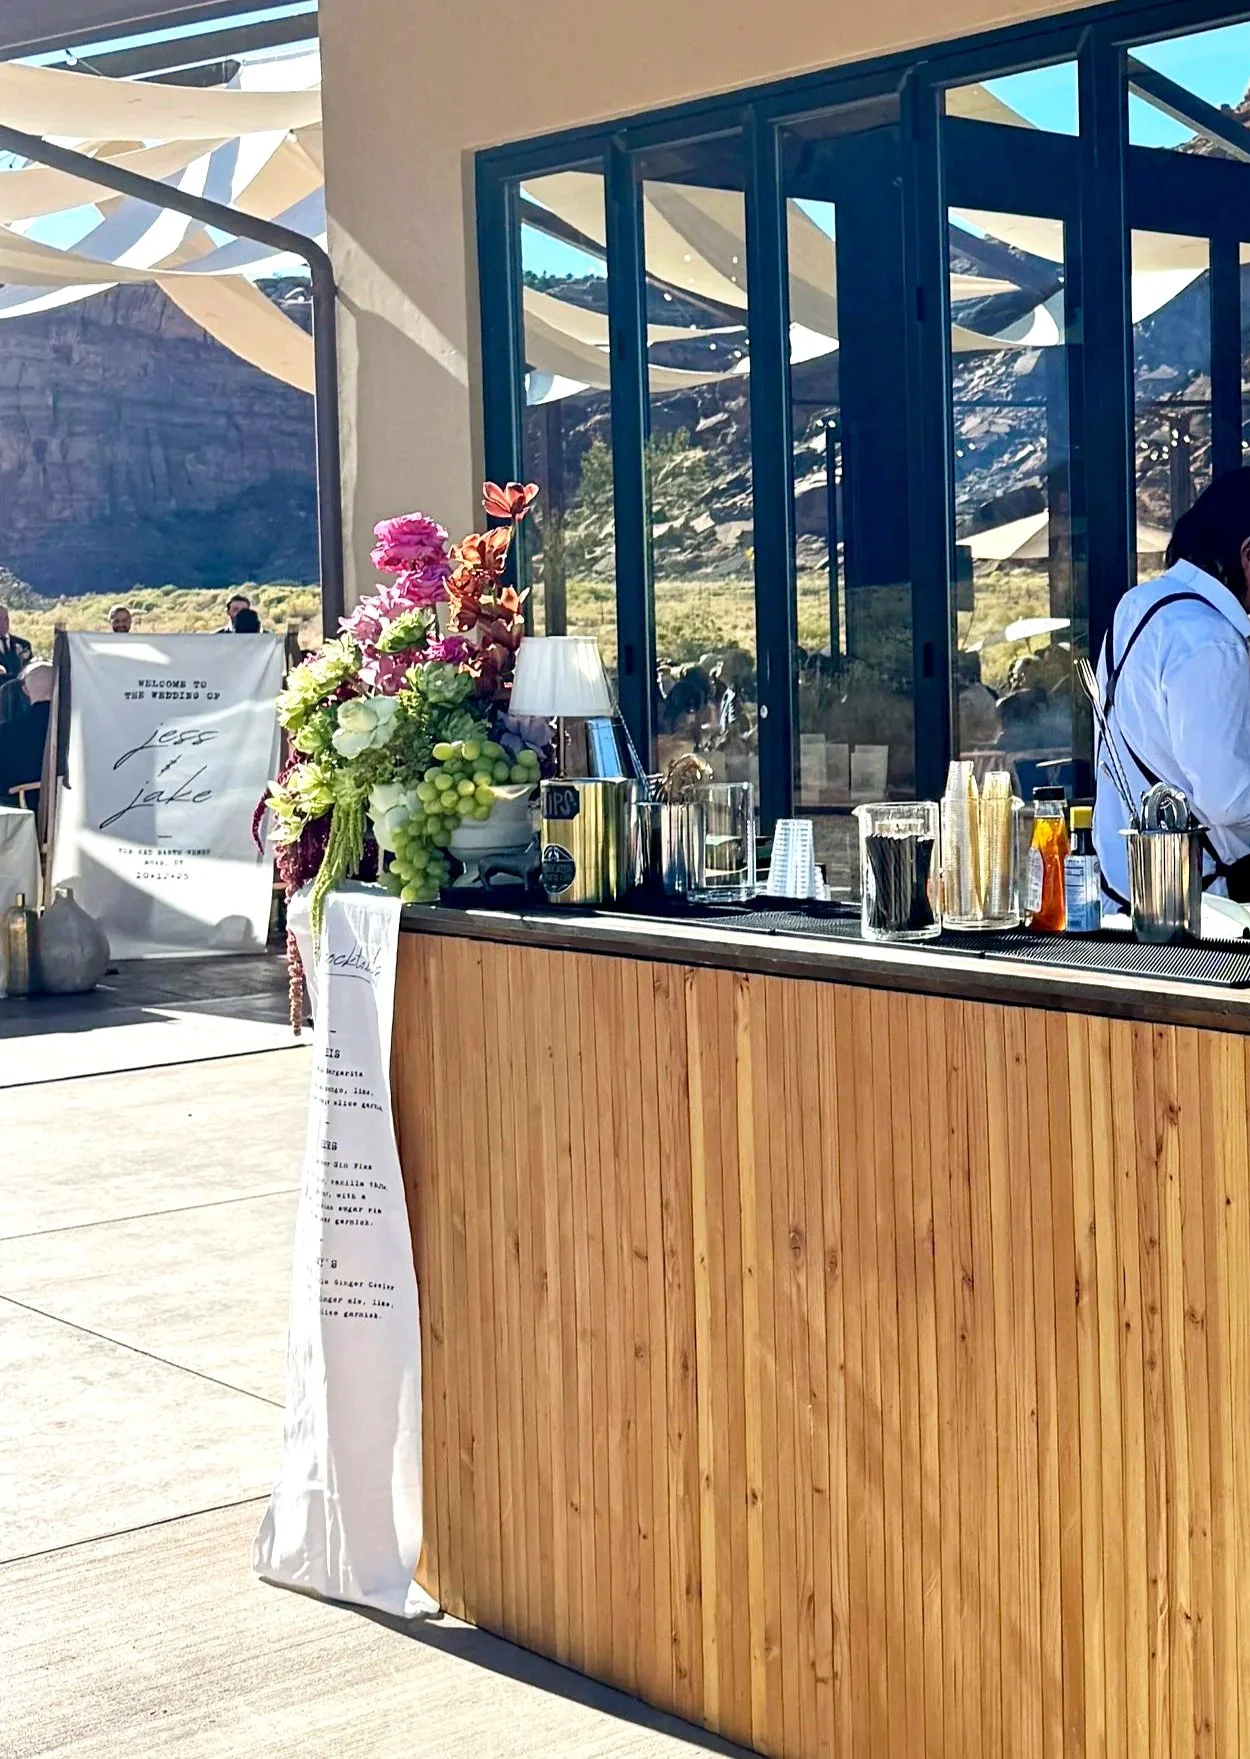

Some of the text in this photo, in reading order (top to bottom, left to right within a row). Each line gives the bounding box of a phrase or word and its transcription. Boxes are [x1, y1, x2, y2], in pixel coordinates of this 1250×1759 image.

[124, 691, 220, 700] THE WEDDING OF
[138, 680, 207, 688] WELCOME TO
[113, 722, 219, 770] jess
[99, 764, 213, 830] jake
